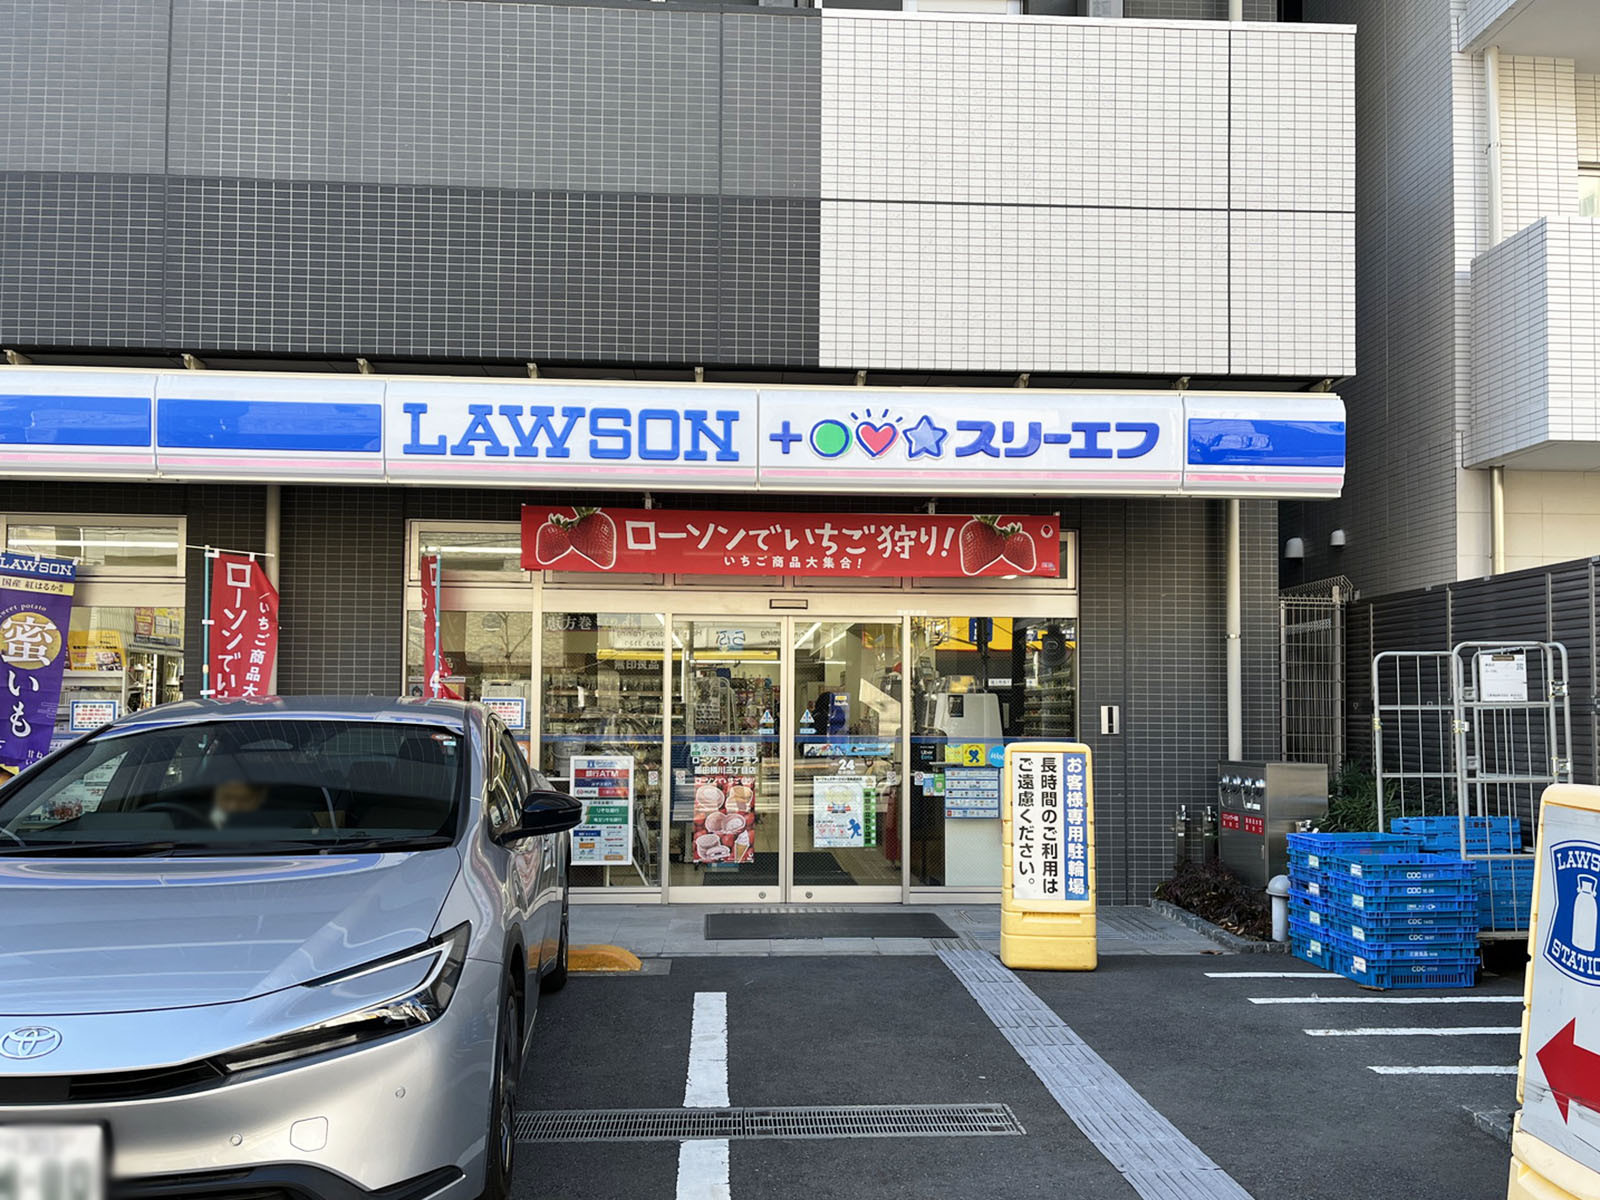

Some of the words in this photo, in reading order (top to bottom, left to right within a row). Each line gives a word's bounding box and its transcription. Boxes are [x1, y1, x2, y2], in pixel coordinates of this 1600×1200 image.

[403, 402, 740, 462] LAWSON
[955, 420, 1161, 459] スリーエフ
[625, 518, 955, 561] ローソンでいちご狩り！
[0, 557, 73, 576] LAWSON
[724, 555, 863, 570] いちご商品大集合！
[0, 604, 17, 619] weet
[20, 603, 47, 612] potato
[1, 615, 58, 738] 蜜いも
[838, 759, 856, 770] 24
[1017, 757, 1035, 885] ご遠慮ください。
[1040, 757, 1059, 895] 長時間のご利用は
[1066, 757, 1085, 896] お客様専用駐輪場
